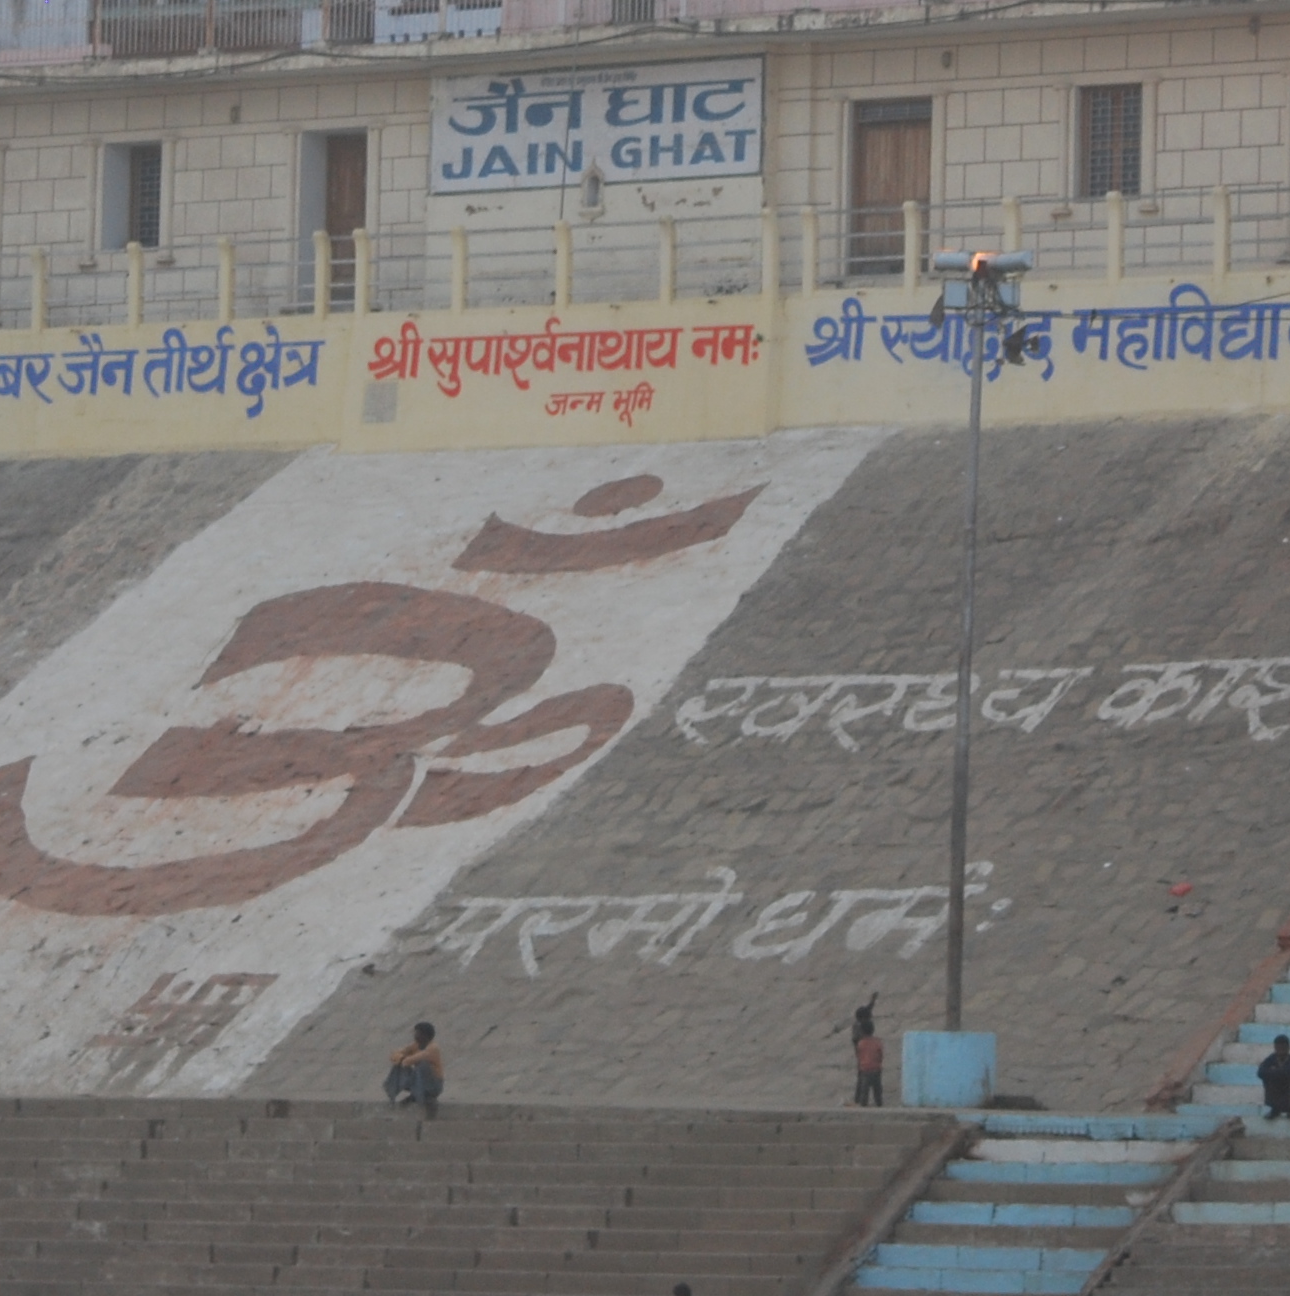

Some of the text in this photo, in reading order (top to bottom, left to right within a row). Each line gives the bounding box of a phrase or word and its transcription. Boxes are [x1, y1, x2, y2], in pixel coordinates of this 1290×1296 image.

[447, 78, 756, 136] जैन घाट
[441, 129, 757, 180] JAIN GHAT
[367, 320, 422, 381] श्री
[804, 297, 877, 368] श्री
[58, 333, 137, 399] जैन
[142, 322, 235, 399] तीर्थ
[234, 319, 326, 420] क्षेत्र
[545, 382, 657, 427] जन्म भूमि
[433, 864, 745, 978] परमो
